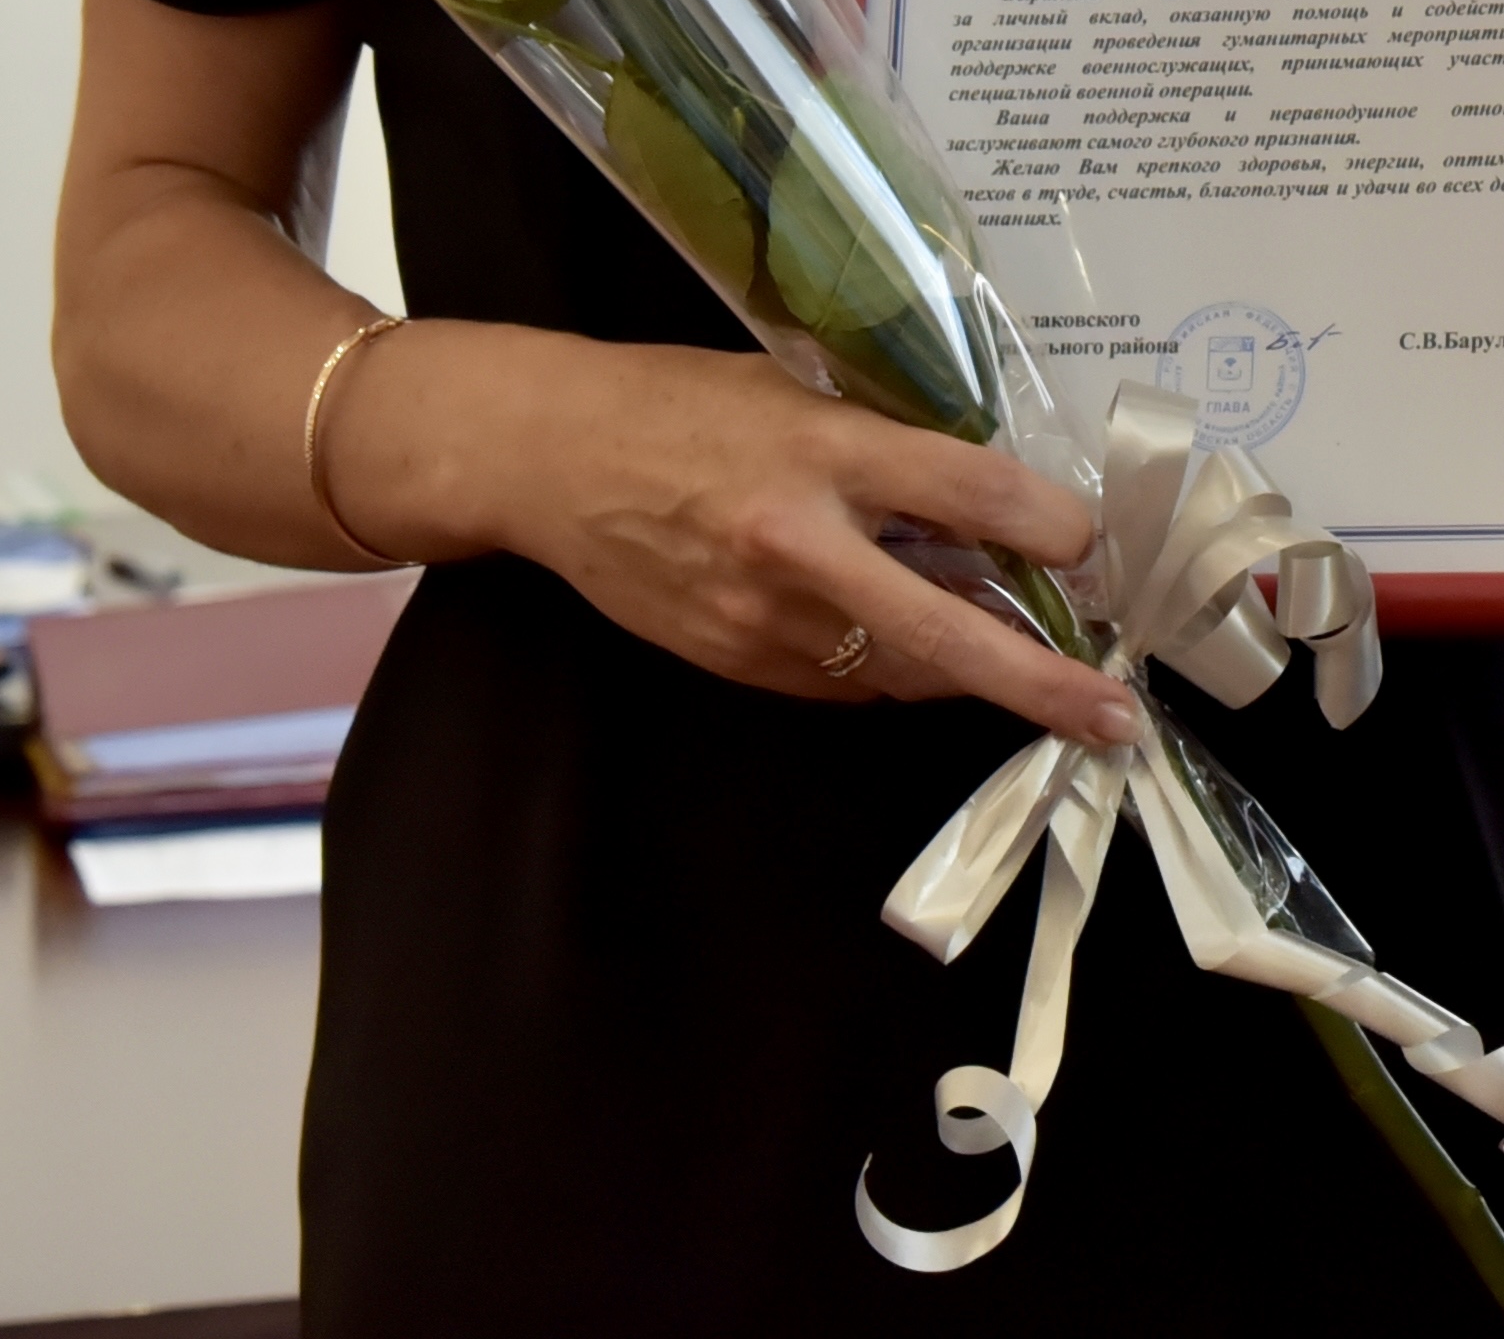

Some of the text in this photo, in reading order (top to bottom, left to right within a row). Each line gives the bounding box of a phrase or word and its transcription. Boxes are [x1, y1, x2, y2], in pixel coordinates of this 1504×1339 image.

[953, 14, 974, 27] за
[992, 8, 1069, 27] личный
[1088, 8, 1148, 26] вклад,
[1168, 8, 1272, 27] оказанную
[1291, 6, 1369, 22] помощь
[1391, 5, 1404, 19] и
[951, 38, 1073, 57] организации
[1092, 33, 1202, 55] проведения
[1221, 32, 1368, 52] гуманитарных
[949, 60, 1057, 81] поддержке
[1081, 59, 1255, 78] военнослужащих,
[1280, 55, 1425, 76] принимающих
[948, 82, 1254, 104] специальной военной операции.
[995, 109, 1051, 126] Ваша
[1082, 108, 1192, 129] поддержка
[1224, 110, 1237, 123] и
[1269, 103, 1419, 126] неравнодушное
[946, 131, 1361, 156] заслуживают самого глубокого признания.
[991, 158, 1061, 176] Желаю
[1077, 157, 1119, 176] Вам
[1135, 160, 1222, 179] крепкого
[1238, 156, 1327, 177] здоровья,
[1345, 156, 1425, 175] энергии,
[962, 188, 1017, 202] пехов
[1021, 188, 1033, 202] в
[1107, 186, 1193, 201] счастья,
[1198, 181, 1330, 202] благополучия
[1336, 183, 1349, 196] и
[1351, 178, 1411, 200] удачи
[1415, 181, 1438, 195] во
[1442, 180, 1484, 194] всех
[977, 210, 1063, 226] инаниях.
[1108, 336, 1180, 359] района
[1205, 401, 1251, 414] ГЛАВА
